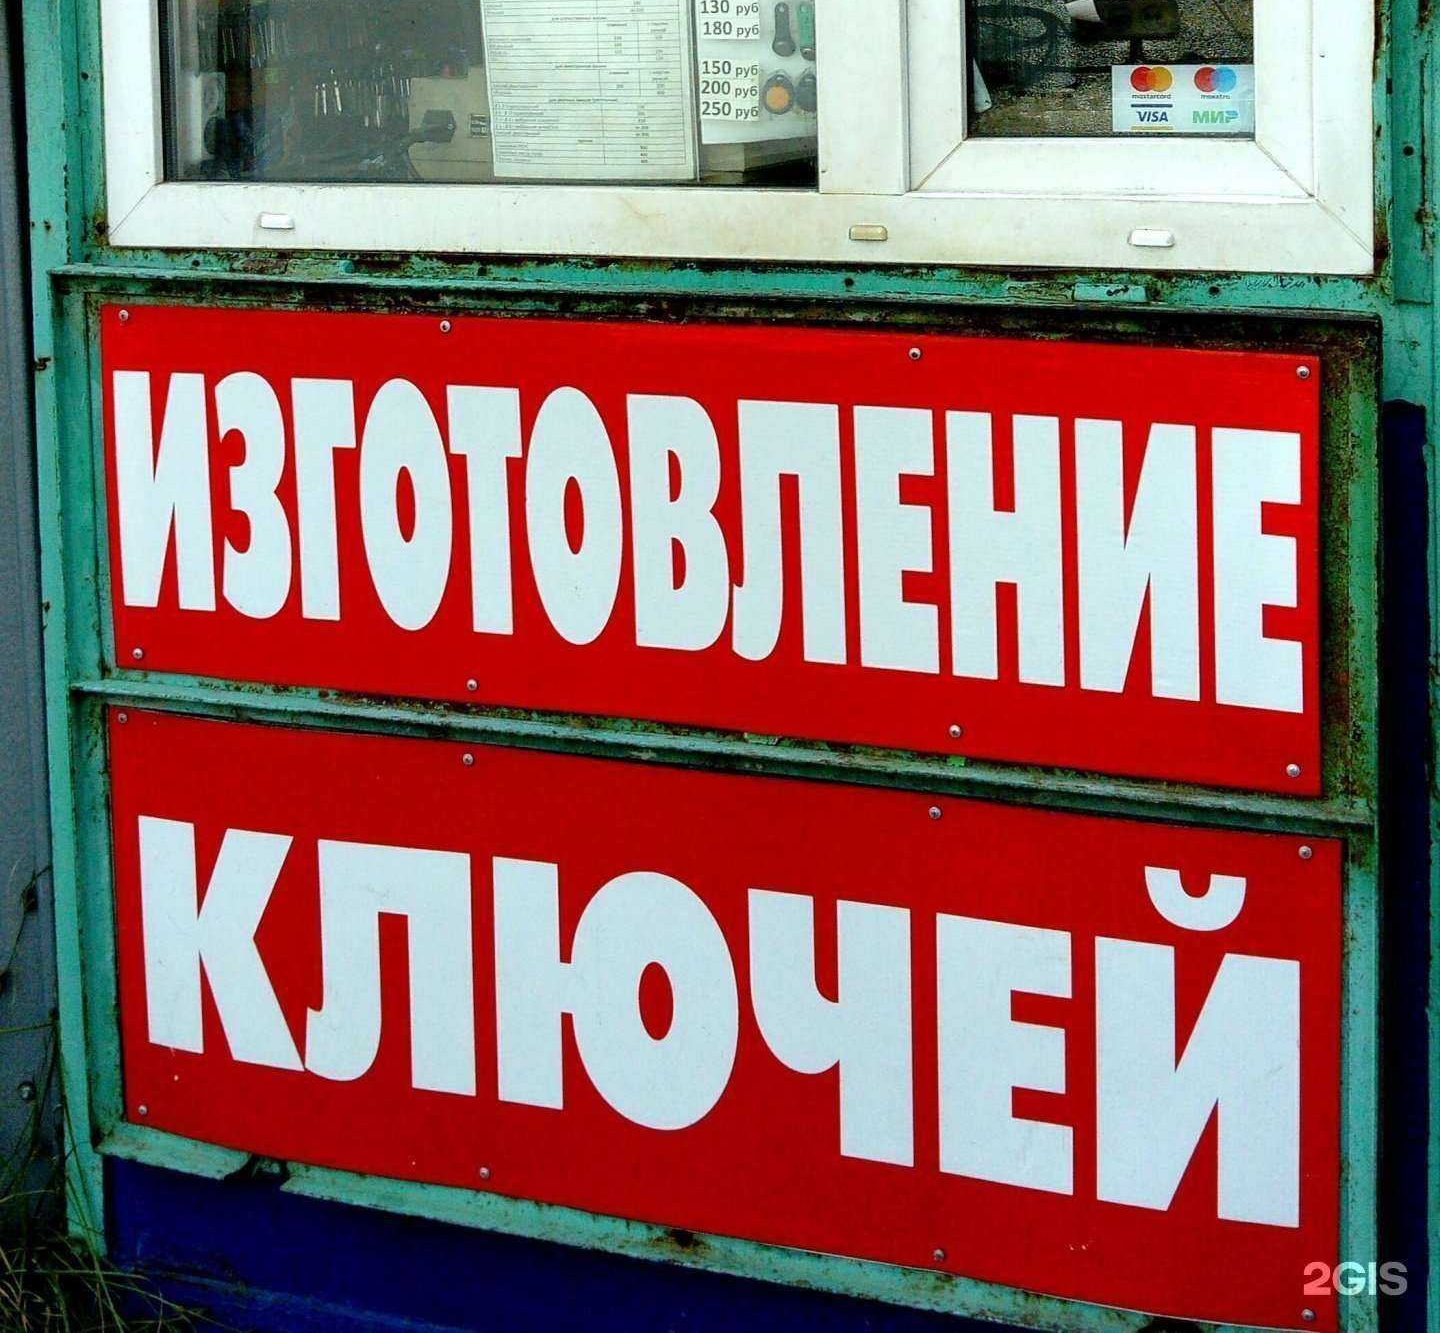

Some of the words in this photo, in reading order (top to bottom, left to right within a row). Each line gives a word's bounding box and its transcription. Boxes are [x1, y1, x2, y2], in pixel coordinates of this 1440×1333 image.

[700, 0, 730, 14] 130
[736, 2, 759, 16] руб
[703, 21, 732, 36] 180
[736, 23, 759, 38] руб
[701, 60, 731, 75] 150
[735, 64, 758, 78] руб
[701, 80, 731, 95] 200
[734, 84, 758, 99] руб
[701, 101, 731, 116] 250
[735, 105, 759, 119] руб
[1136, 111, 1168, 122] VISA
[1192, 110, 1238, 124] МИР
[113, 370, 1304, 714] ИЗГОТОВЛЕНИЕ
[138, 814, 1300, 1229] КЛЮЧЕЙ
